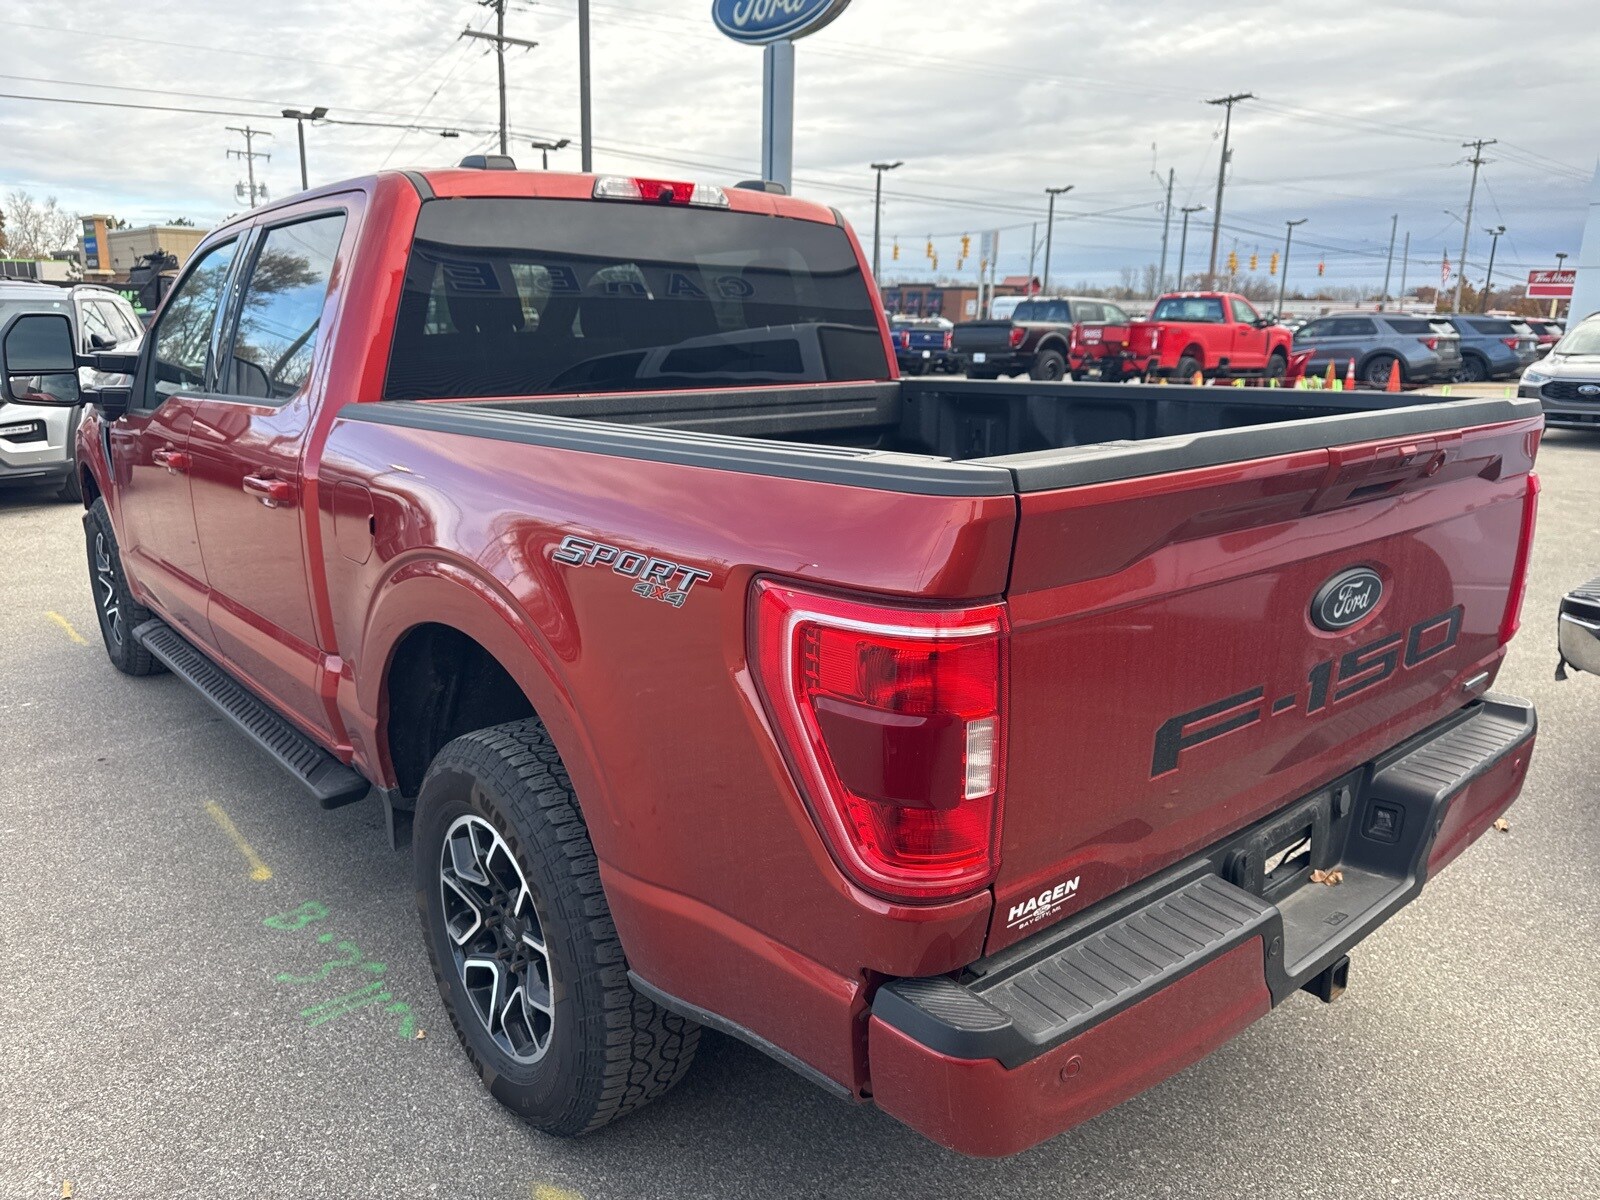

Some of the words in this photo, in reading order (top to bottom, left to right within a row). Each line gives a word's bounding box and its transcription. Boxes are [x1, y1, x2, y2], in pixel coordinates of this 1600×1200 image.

[552, 535, 713, 593] SPORT
[1333, 580, 1372, 619] Ford
[1150, 604, 1465, 781] F-150
[1007, 875, 1080, 922] HAGEN
[1018, 918, 1035, 930] BAY
